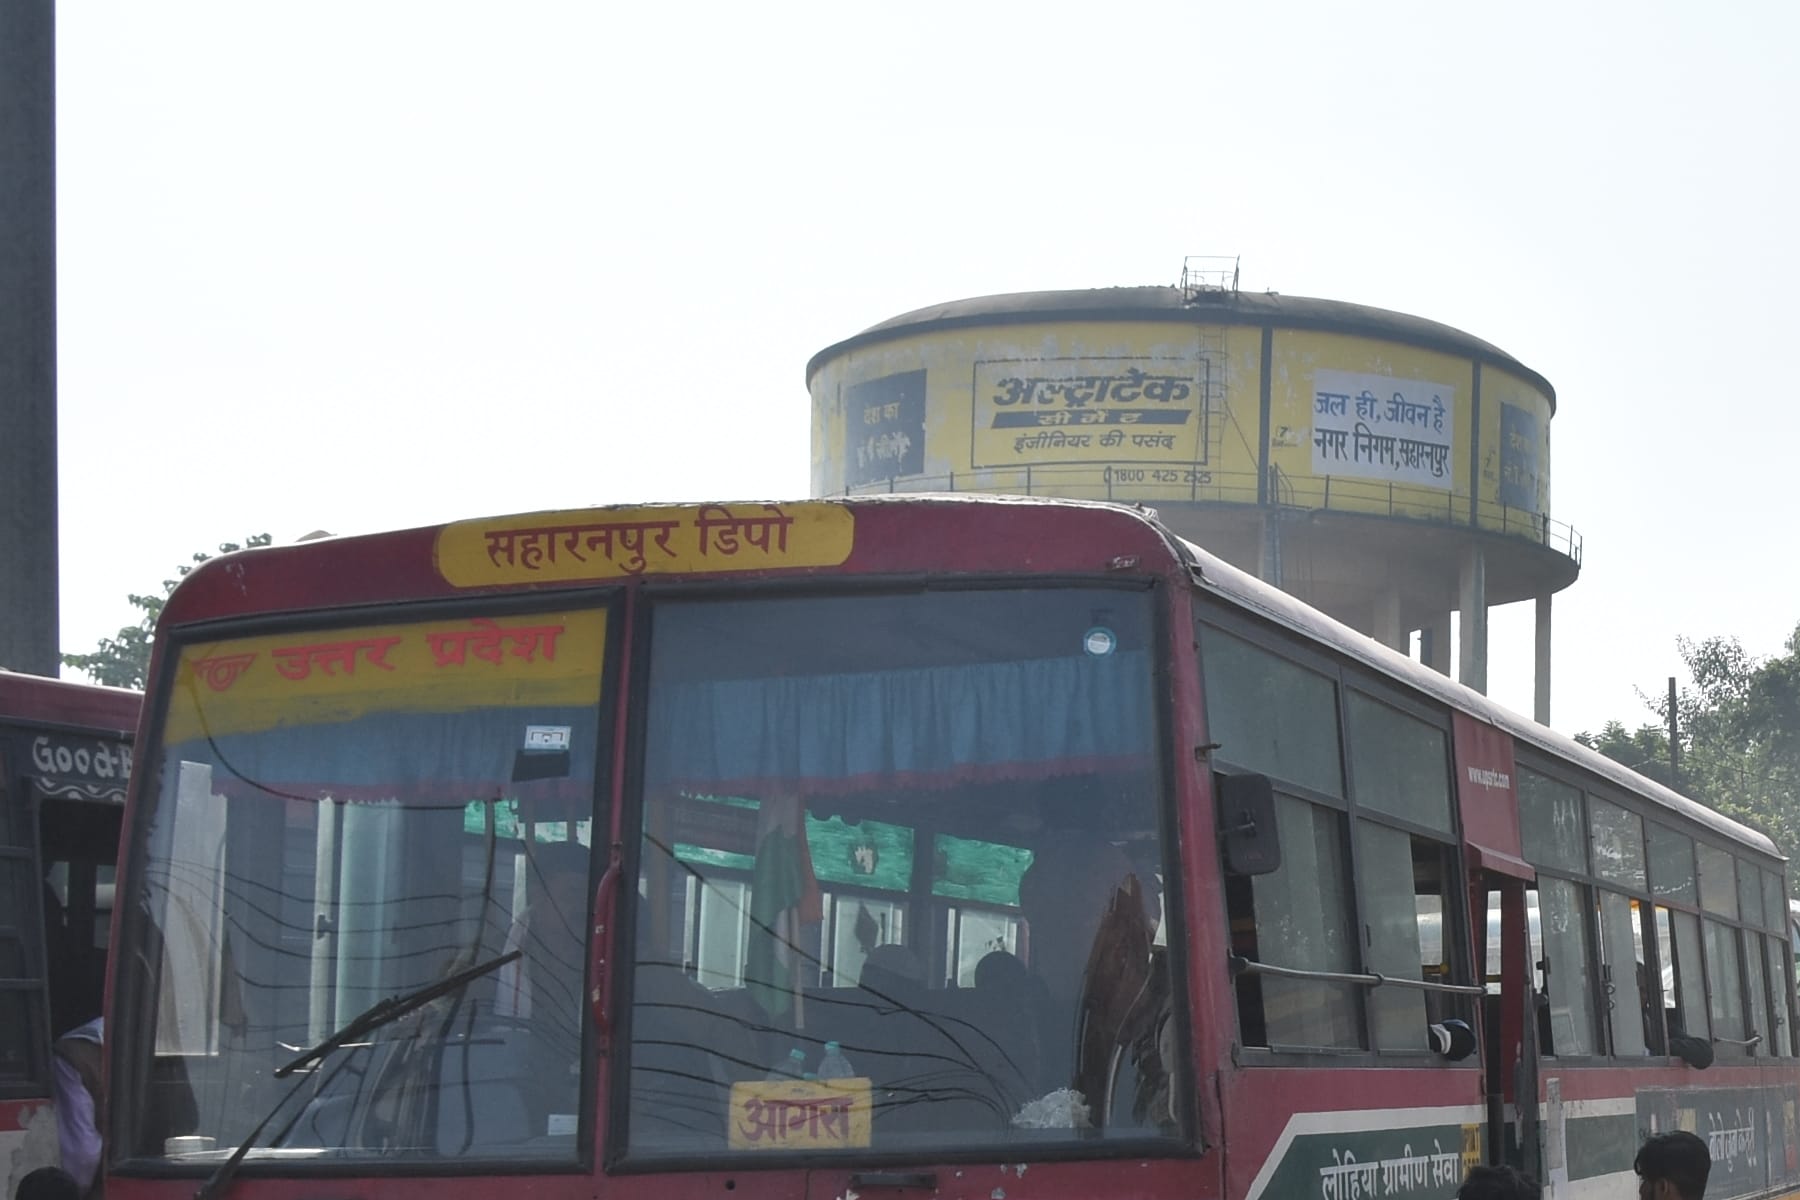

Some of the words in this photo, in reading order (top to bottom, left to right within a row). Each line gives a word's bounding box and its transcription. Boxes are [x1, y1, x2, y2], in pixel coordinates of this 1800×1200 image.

[1314, 391, 1350, 416] जल
[1384, 392, 1431, 428] जीवन
[1433, 394, 1446, 433] है
[1013, 430, 1092, 453] इंजीनियर
[1100, 429, 1124, 448] की
[1132, 430, 1176, 450] पसंद
[1314, 428, 1348, 461] नगर
[1152, 469, 1178, 482] 425
[485, 520, 680, 575] सहारनपुर
[693, 503, 794, 556] डिपो
[271, 635, 403, 681] उत्तर
[426, 617, 565, 668] प्रदेश
[737, 1094, 855, 1142] आगरा
[1380, 1143, 1430, 1196] ग्रामीण
[1430, 1138, 1460, 1188] सेवा
